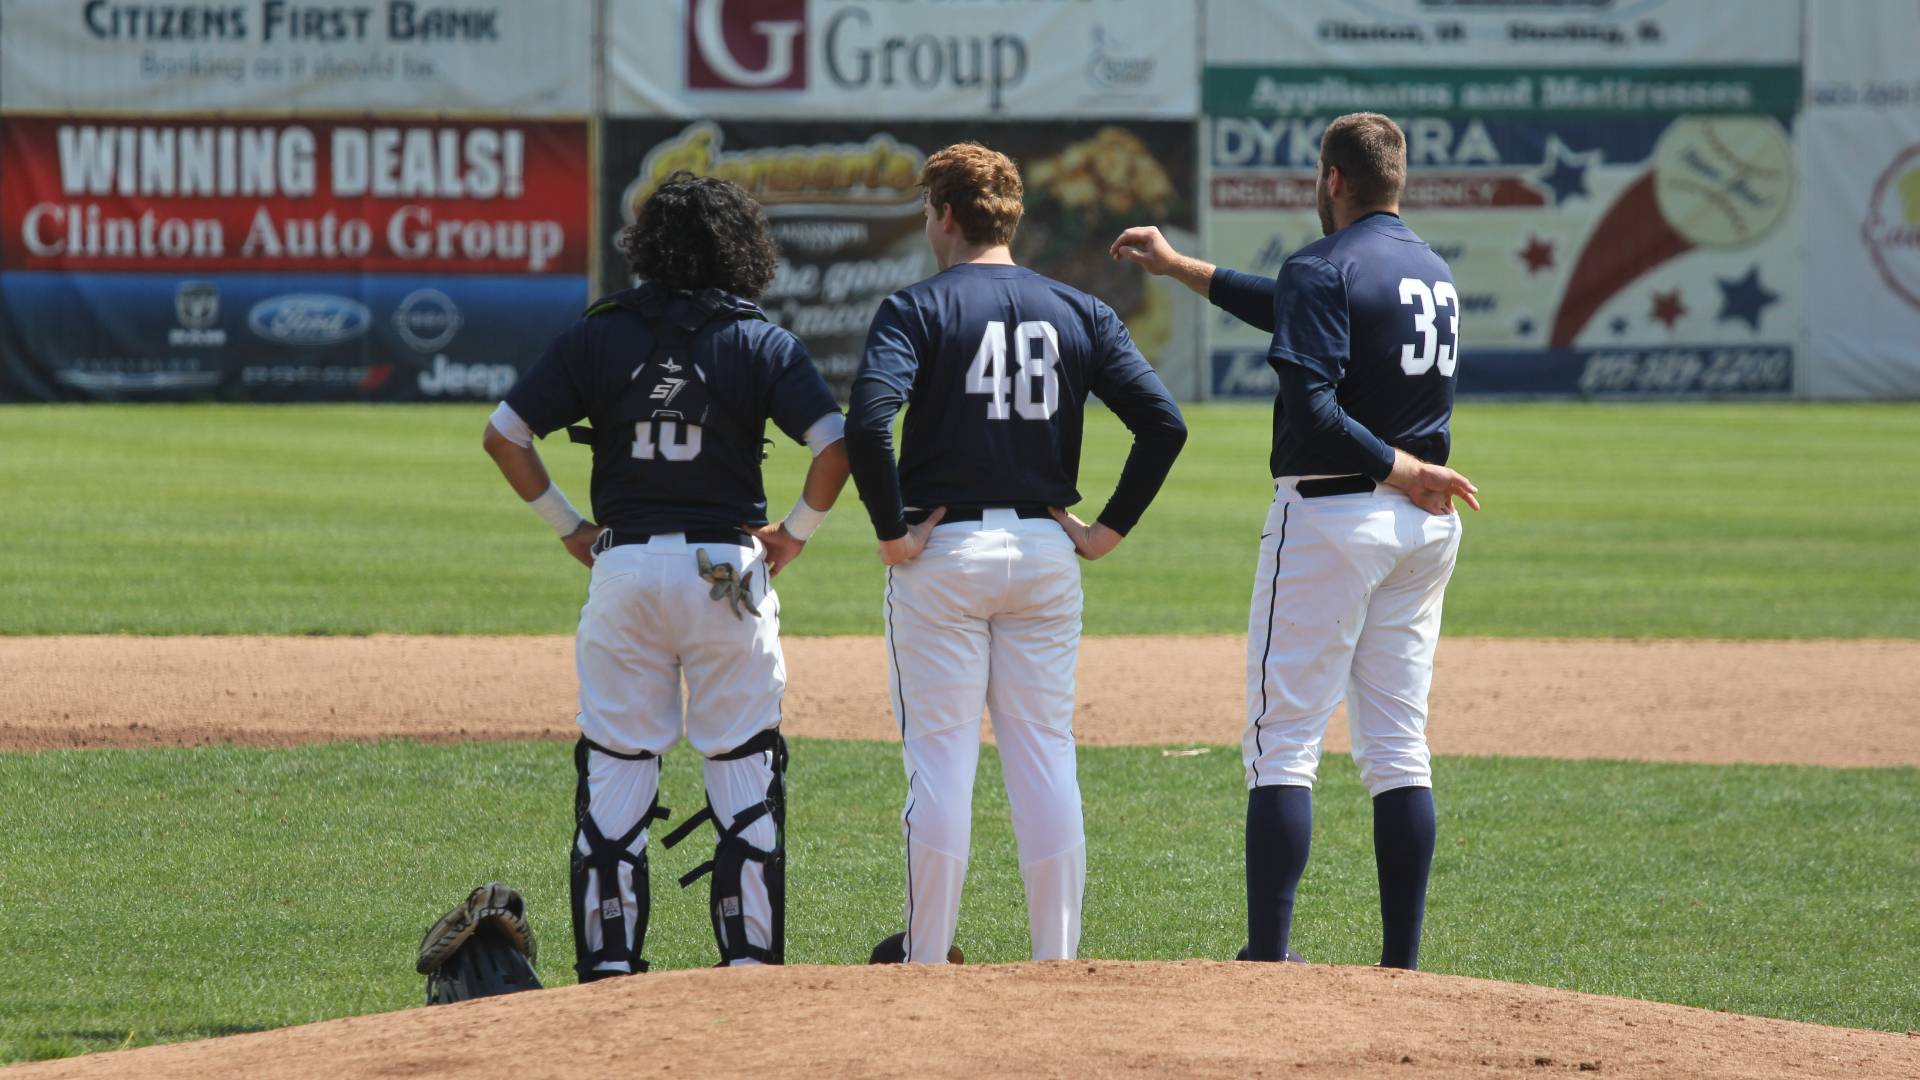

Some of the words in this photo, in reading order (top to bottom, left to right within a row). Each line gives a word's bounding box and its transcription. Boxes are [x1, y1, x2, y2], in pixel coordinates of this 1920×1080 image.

[84, 0, 248, 41] CITIZENS
[263, 0, 371, 43] FIRST
[388, 0, 499, 43] BANK
[823, 5, 1029, 110] Group
[57, 126, 317, 197] WINNING
[331, 127, 525, 199] DEALS!
[22, 201, 224, 258] Clinton
[241, 204, 373, 259] Auto
[387, 204, 565, 273] Group
[168, 328, 227, 347] RAM
[1398, 277, 1459, 377] 33
[417, 353, 518, 398] Jeep
[965, 320, 1060, 420] 48
